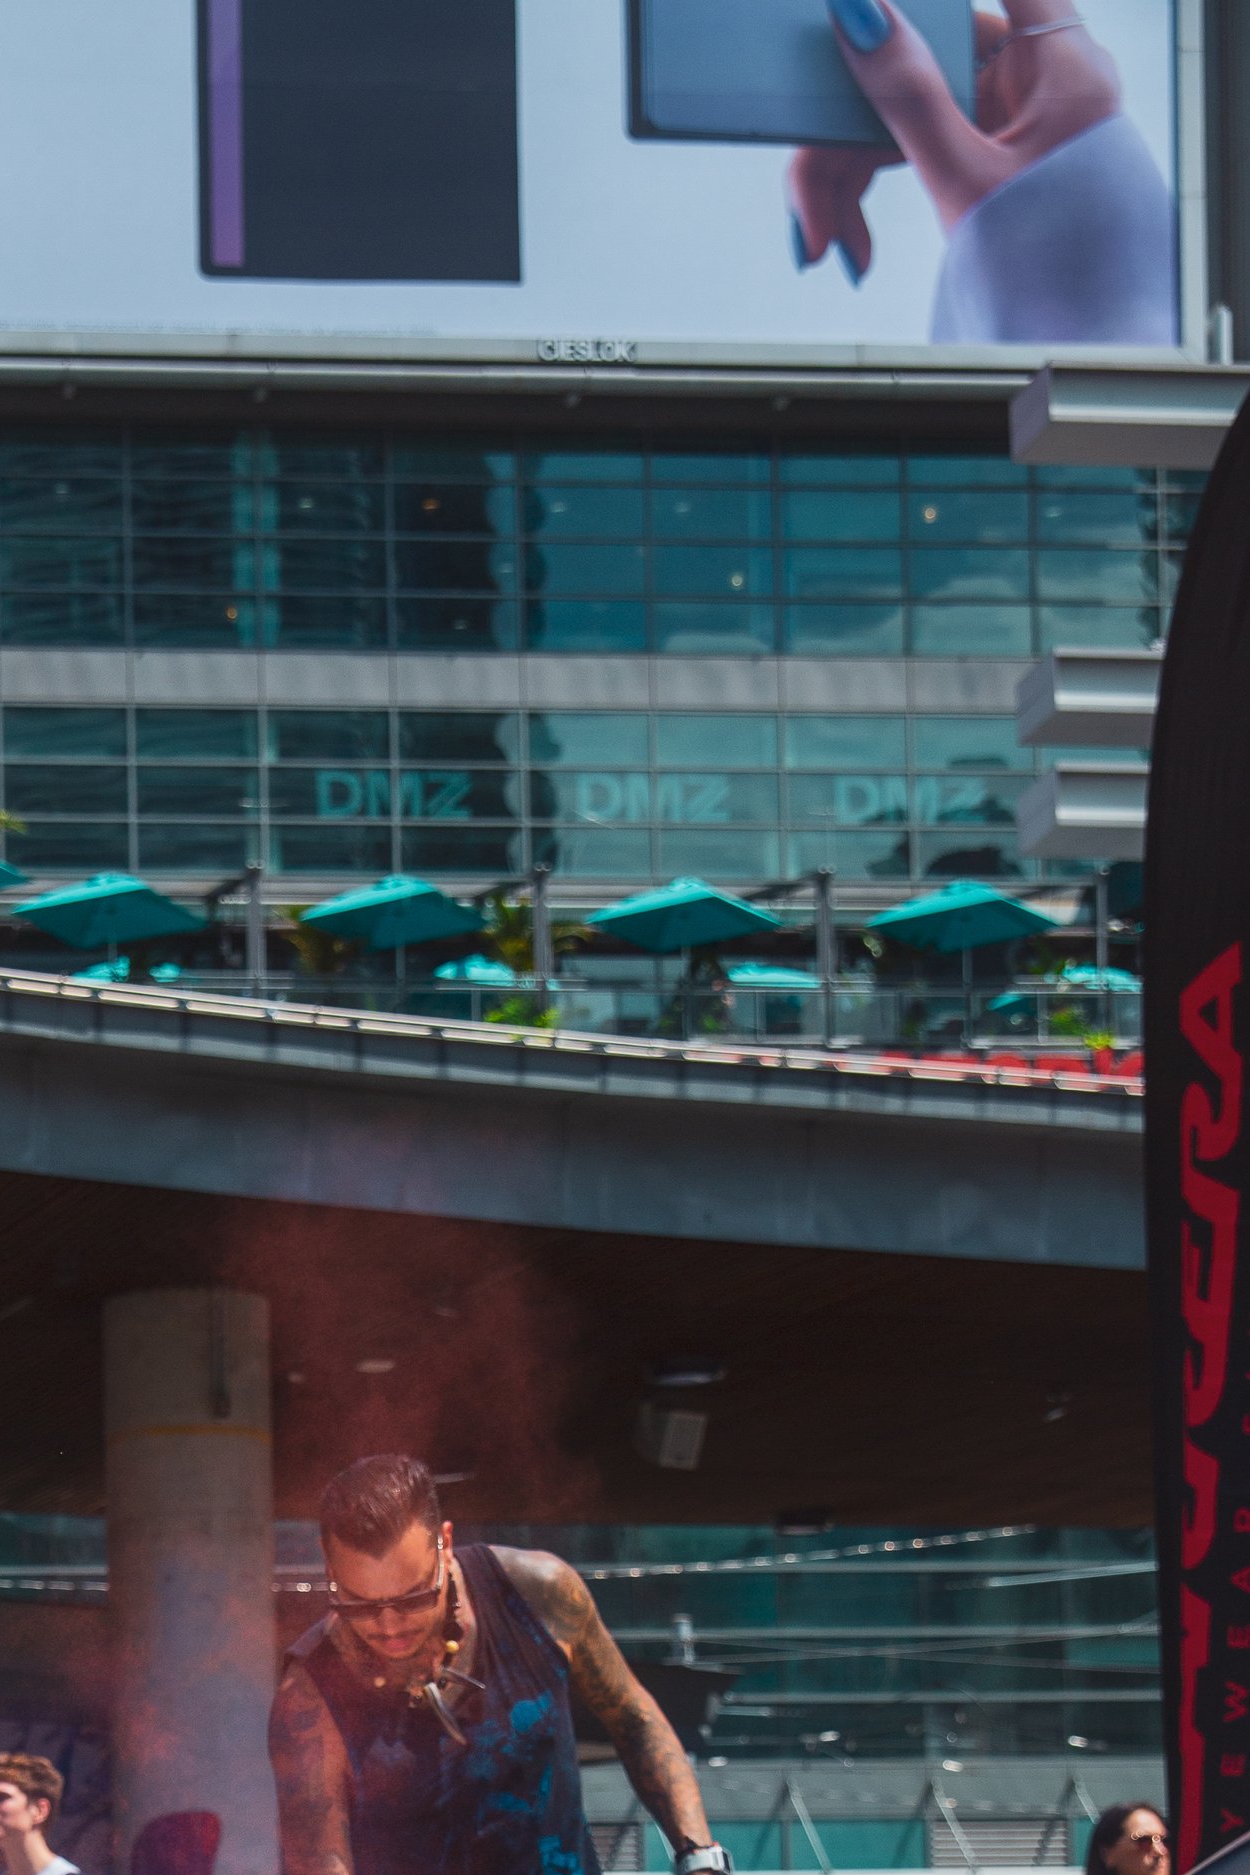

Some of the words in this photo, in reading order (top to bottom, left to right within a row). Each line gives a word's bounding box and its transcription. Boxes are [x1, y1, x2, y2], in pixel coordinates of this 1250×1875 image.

[316, 769, 472, 820] DMZ
[577, 772, 729, 824] DMZ
[835, 775, 987, 825] DMZ
